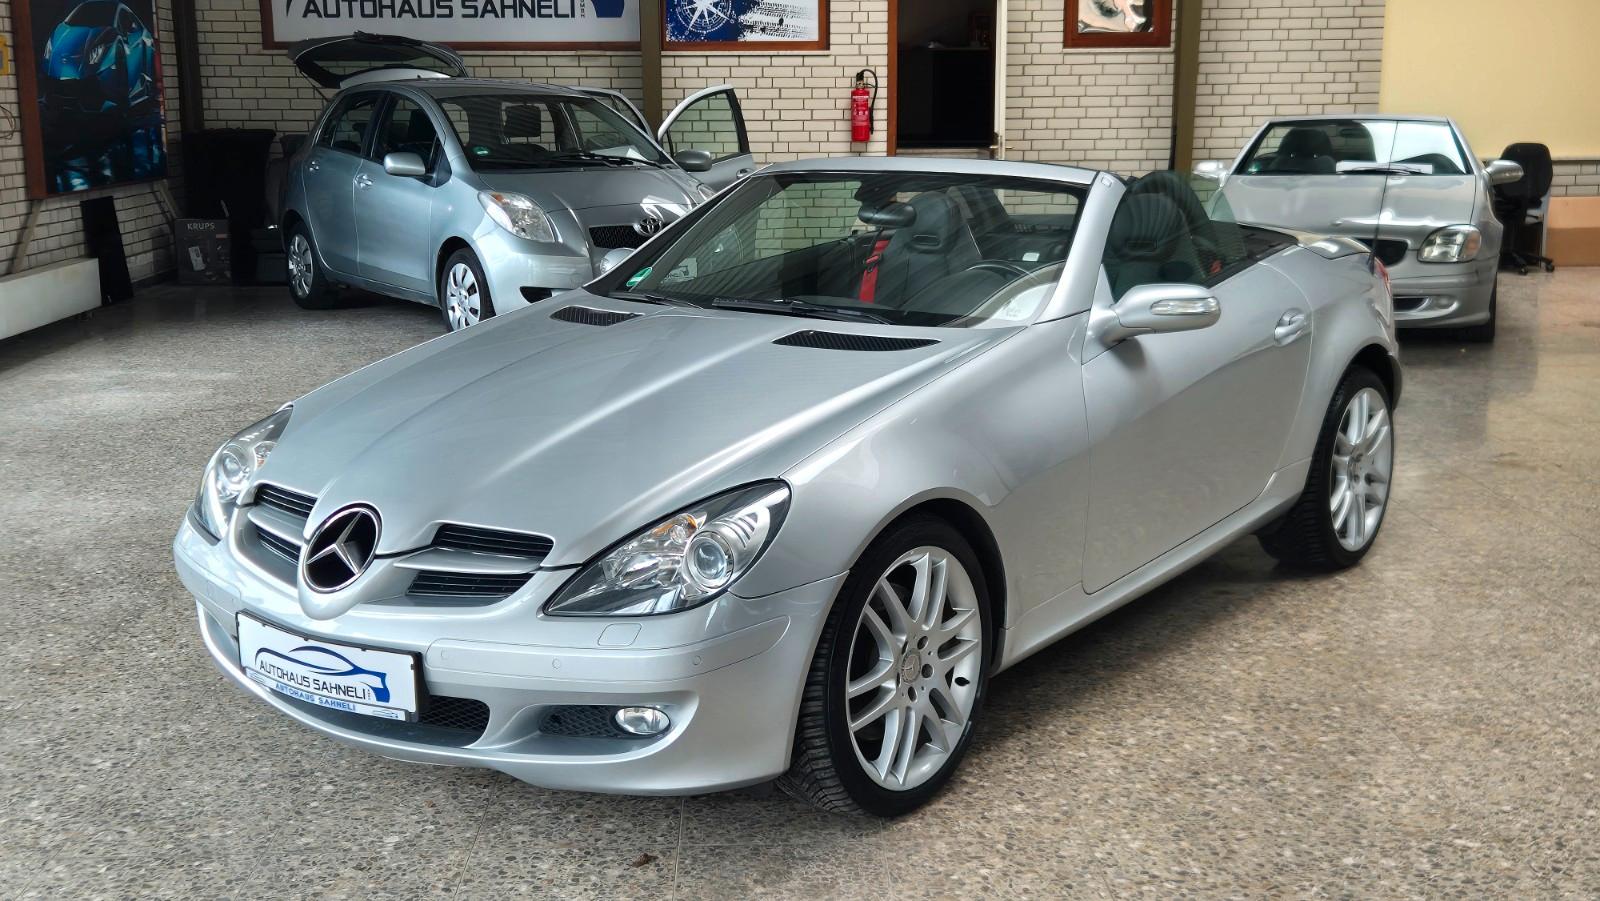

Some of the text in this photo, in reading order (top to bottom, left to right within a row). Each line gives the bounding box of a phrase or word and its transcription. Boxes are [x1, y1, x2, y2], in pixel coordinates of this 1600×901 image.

[302, 0, 576, 18] AUTOHAUS SAHNELI
[187, 222, 216, 231] KRUPS
[259, 659, 311, 688] AUTOHAUS
[312, 678, 366, 700] SAHNELI
[275, 682, 356, 711] AUTOHAUS SAHNELI
